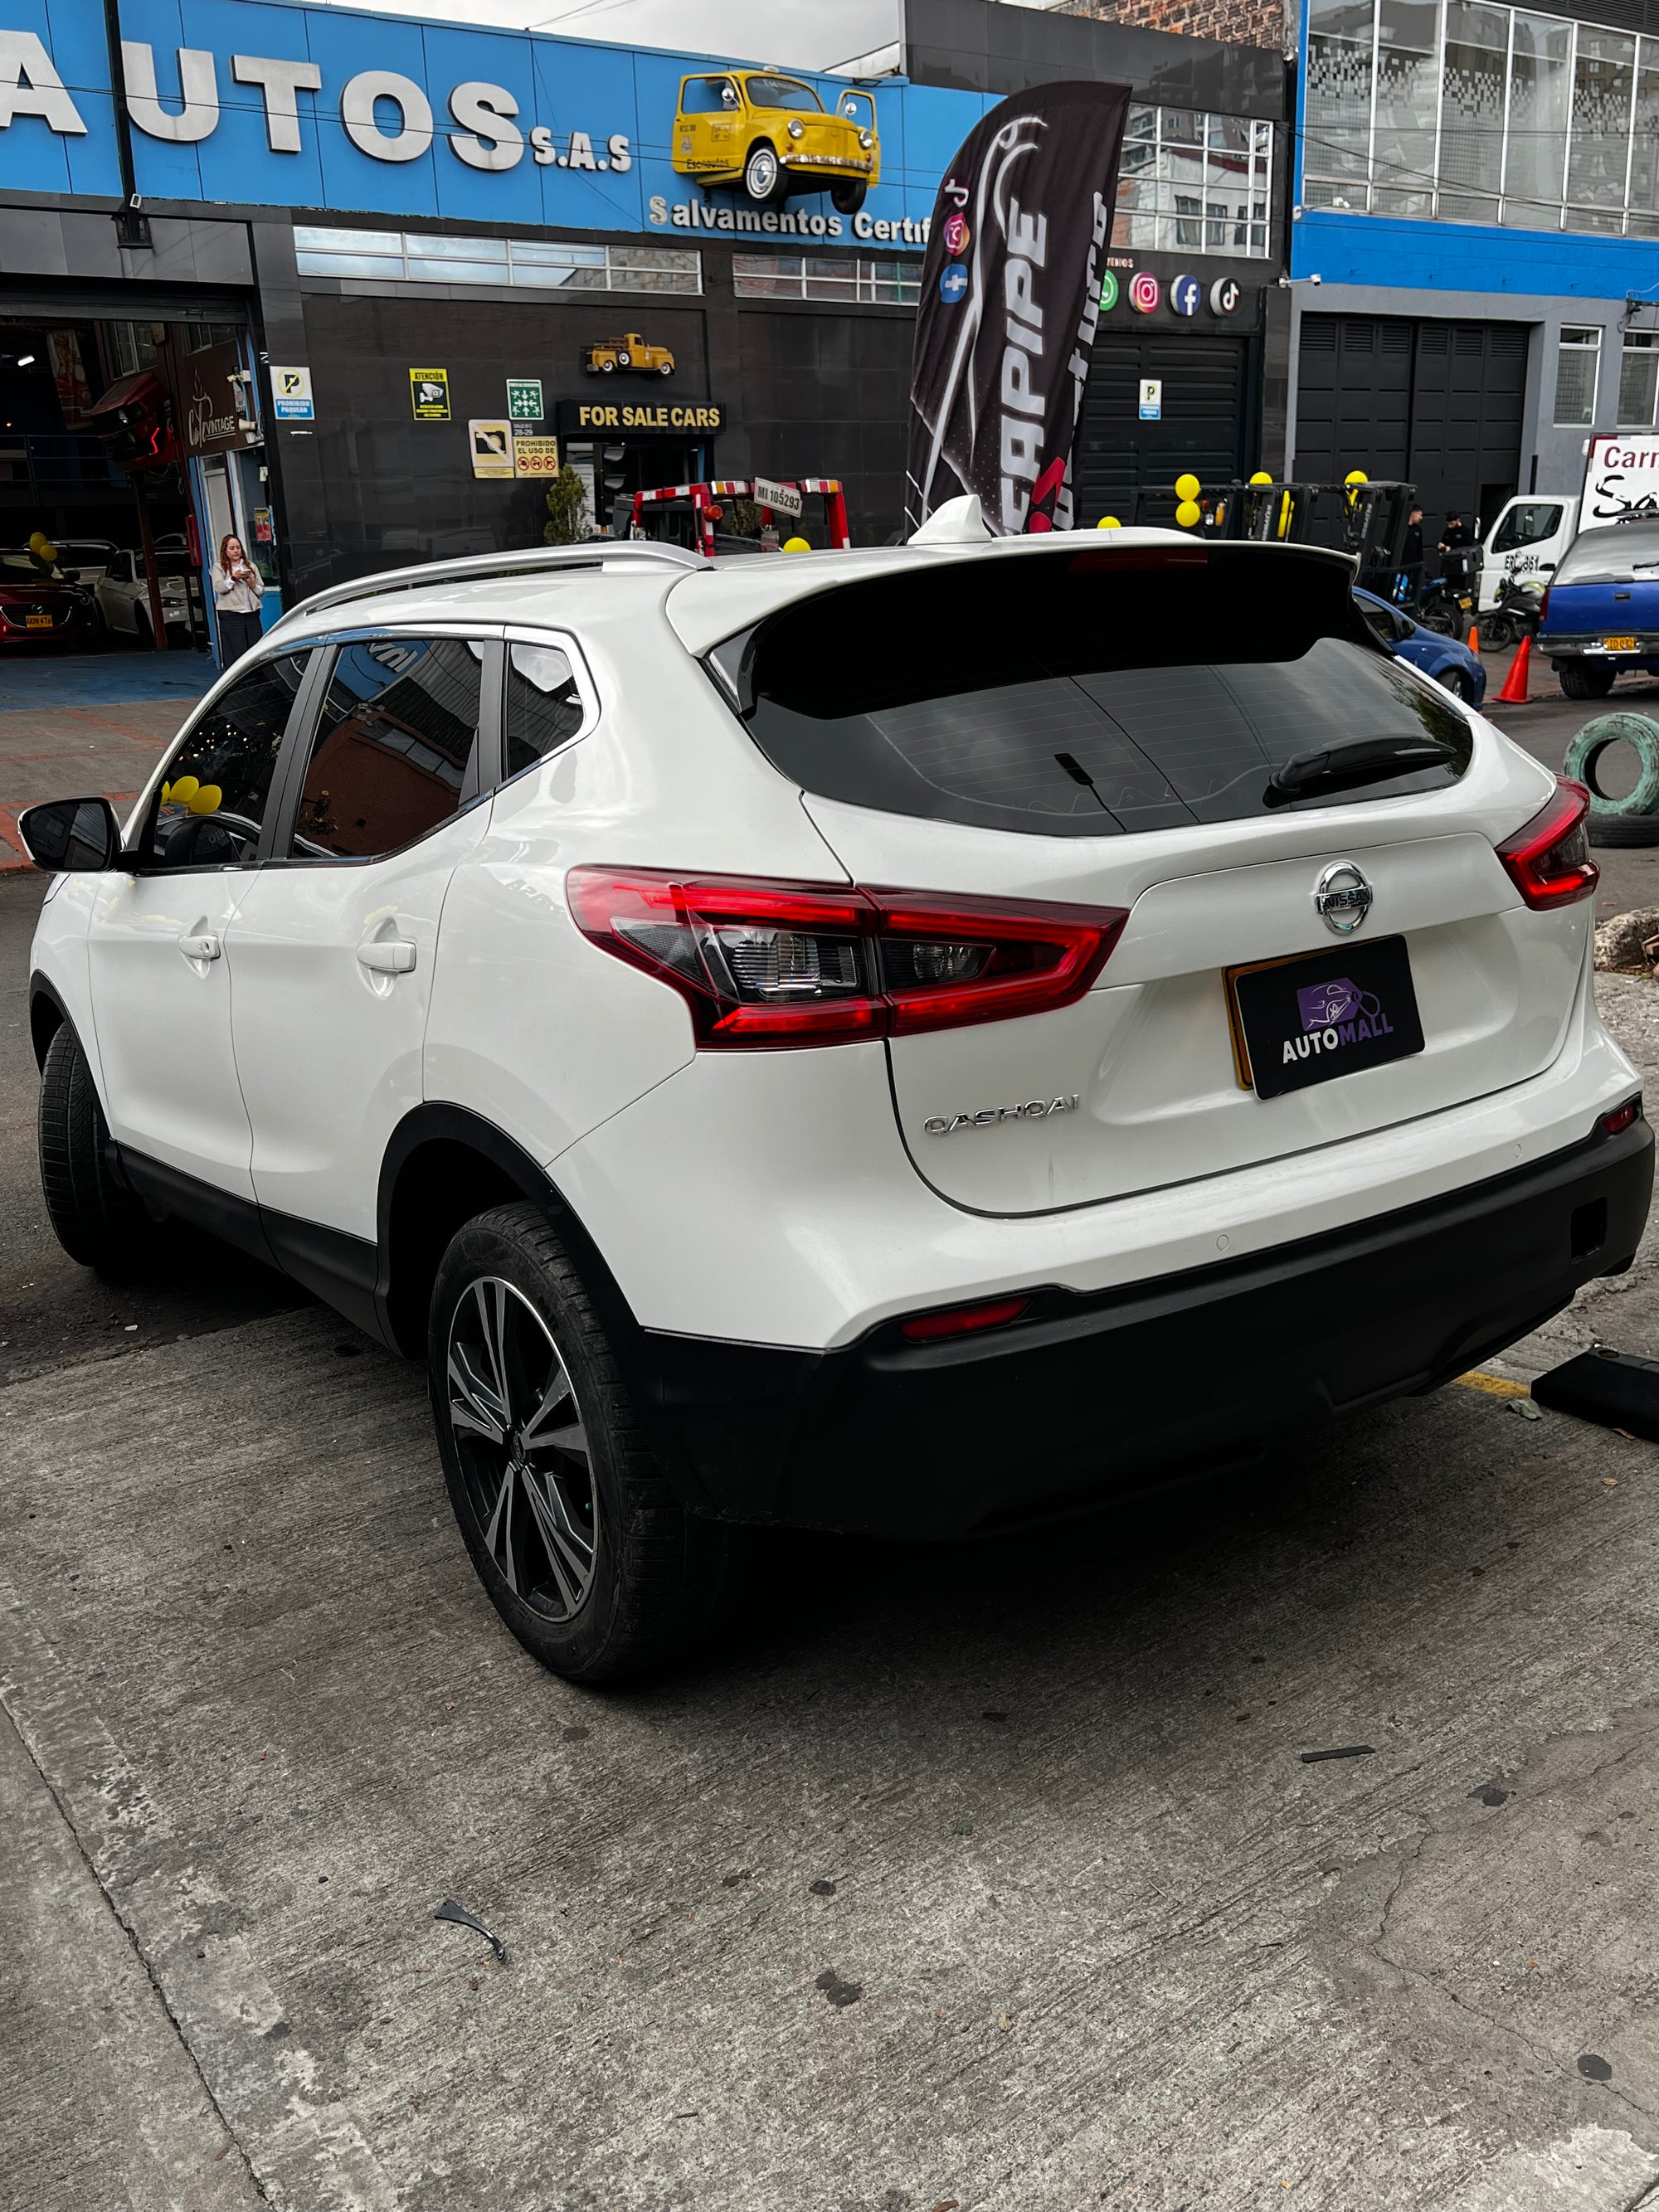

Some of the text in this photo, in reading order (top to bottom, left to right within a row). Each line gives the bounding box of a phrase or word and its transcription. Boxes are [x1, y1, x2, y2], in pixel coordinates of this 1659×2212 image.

[0, 30, 632, 173] AUTOS S.A.S
[649, 196, 843, 237] Salvamentos
[206, 416, 236, 435] VINTAGE
[579, 406, 720, 427] FOR SALE CARS
[757, 486, 800, 510] MI 105293
[1325, 891, 1370, 911] NISSAN
[1282, 1014, 1394, 1064] AUTOMALL
[923, 1094, 1079, 1135] QASHQAI
